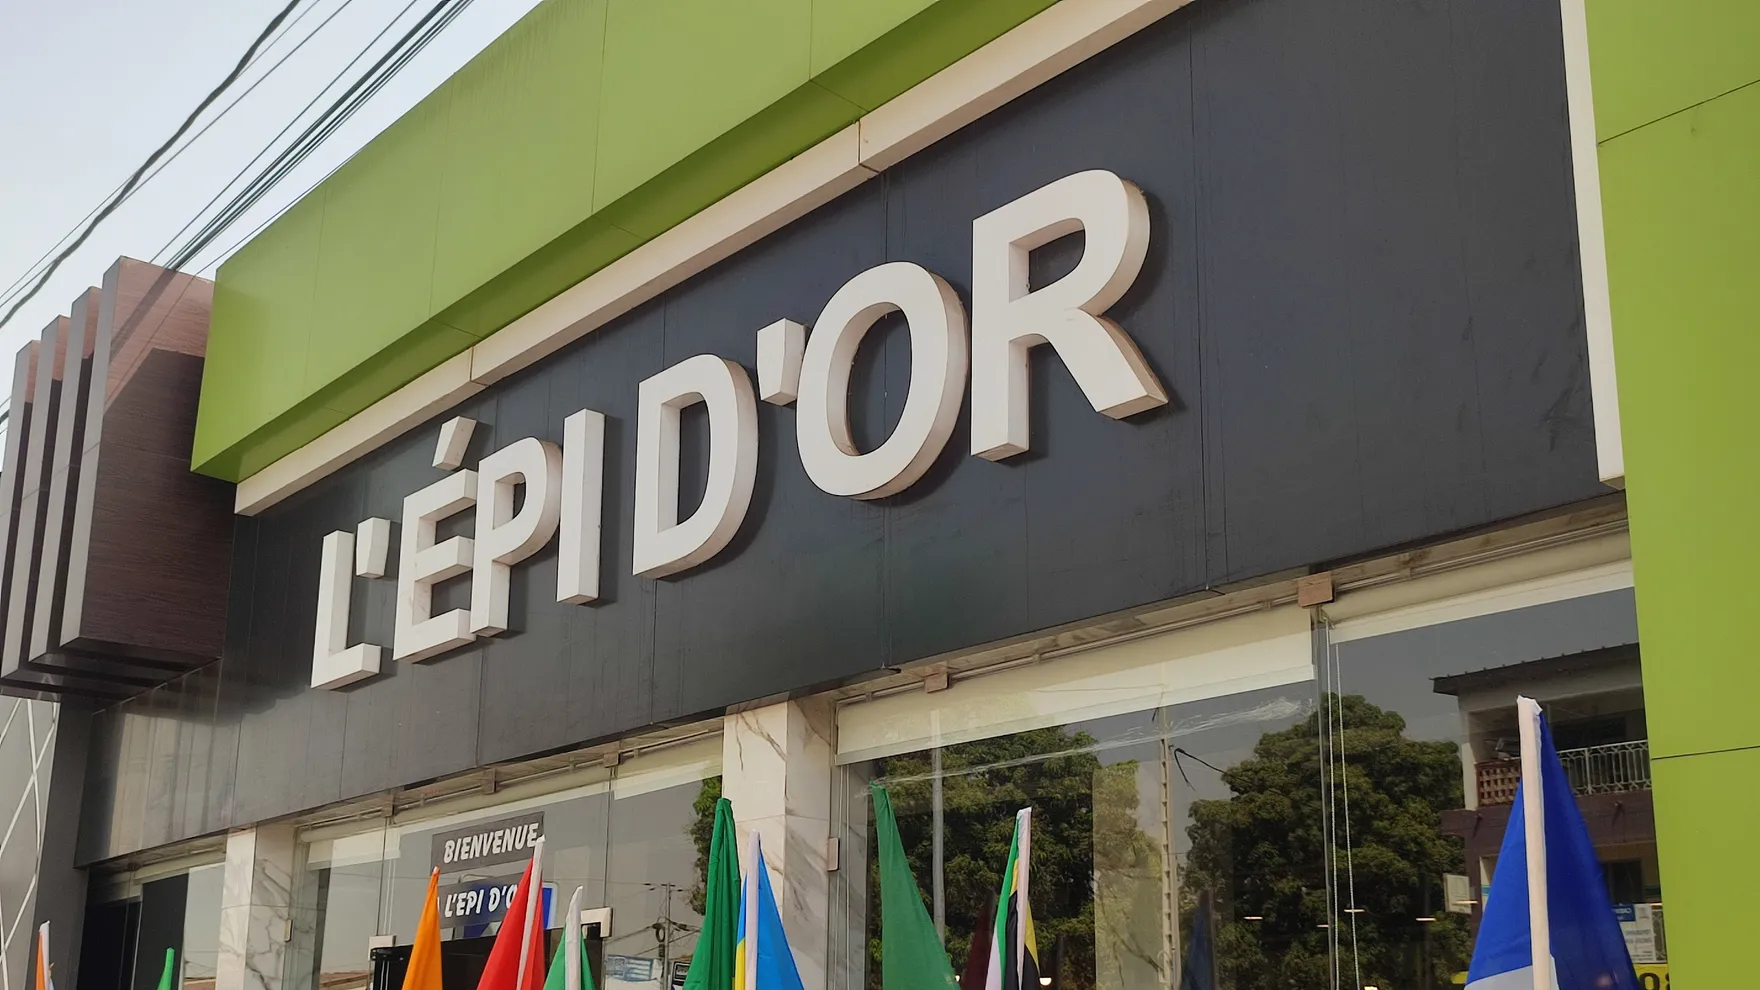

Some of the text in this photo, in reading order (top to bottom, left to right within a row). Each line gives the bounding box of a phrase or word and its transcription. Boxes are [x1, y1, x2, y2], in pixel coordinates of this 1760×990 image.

[311, 169, 1168, 689] L'ÉPI D'OR
[443, 823, 539, 863] BIENVENUE
[444, 889, 485, 917] L'EPI
[488, 884, 518, 912] D'O
